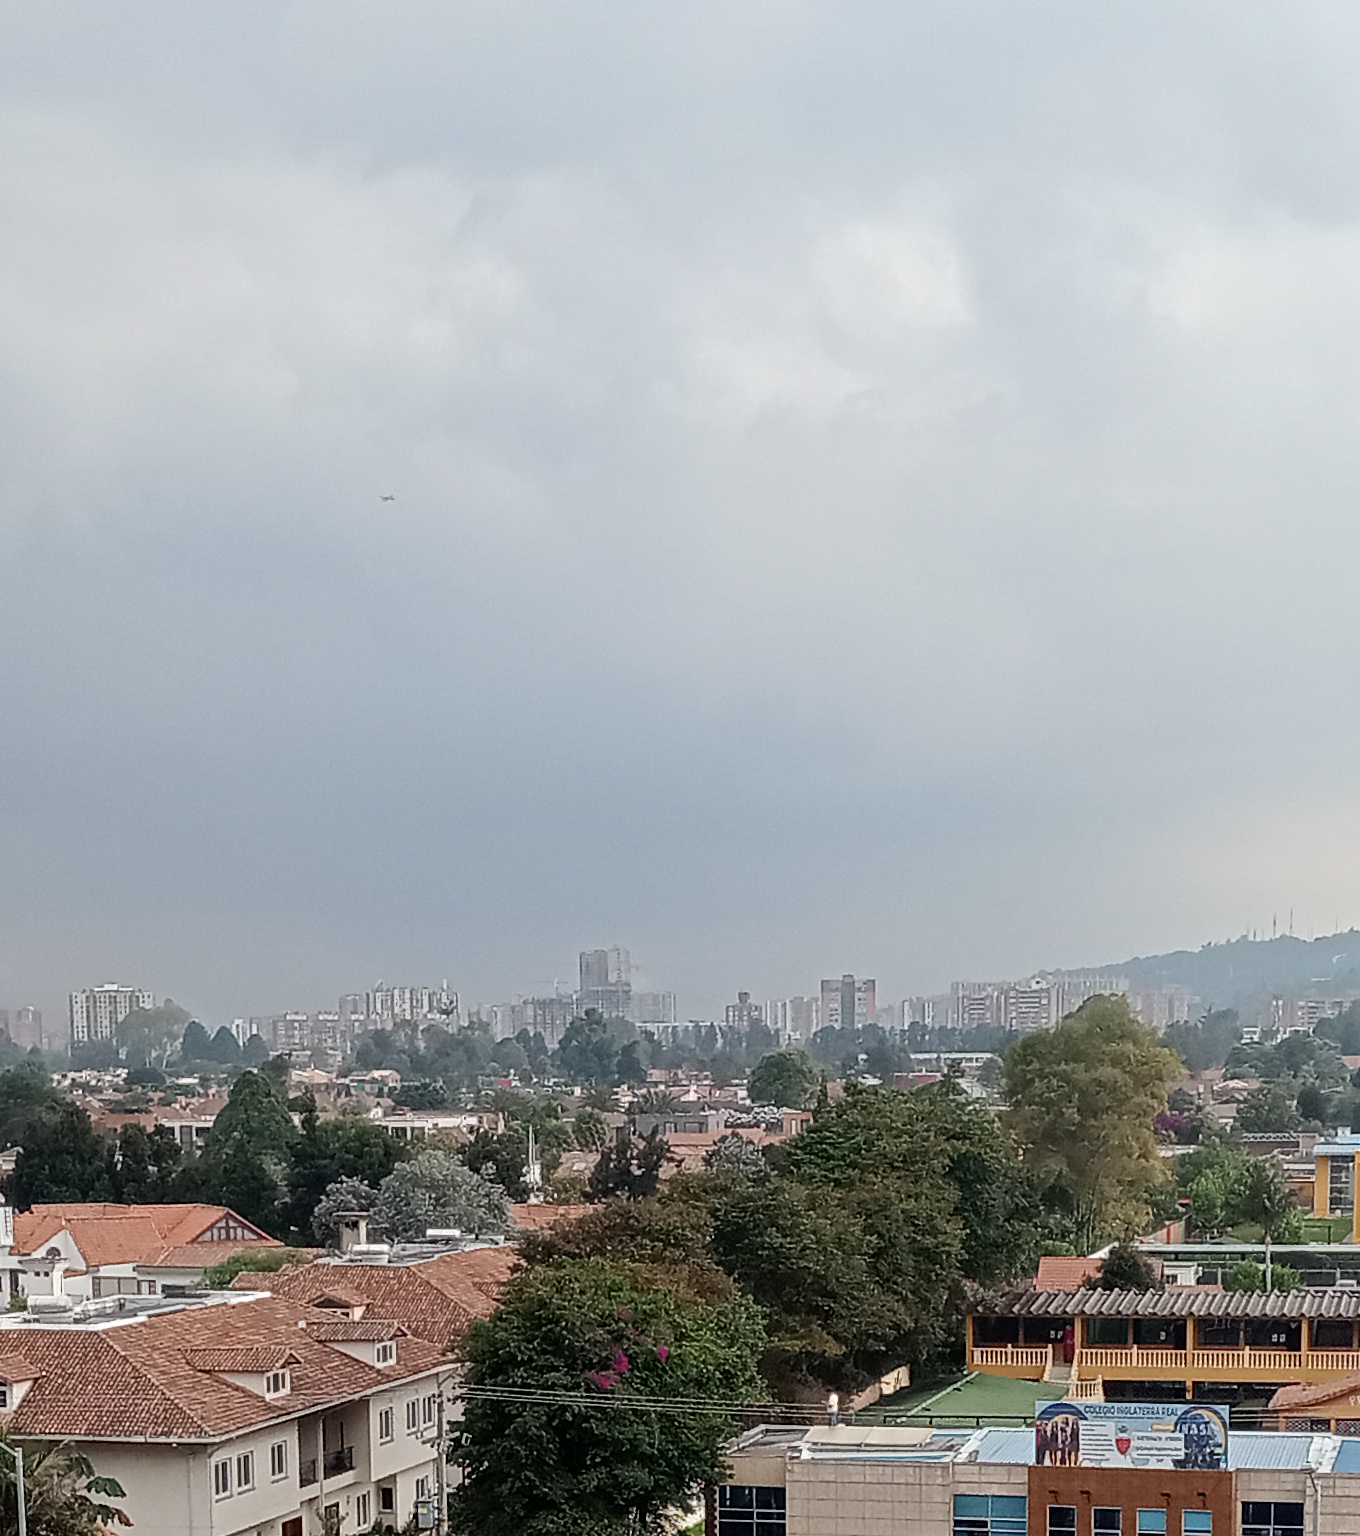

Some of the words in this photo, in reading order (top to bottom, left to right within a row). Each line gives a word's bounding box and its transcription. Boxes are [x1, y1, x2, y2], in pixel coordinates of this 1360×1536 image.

[1083, 1405, 1116, 1416] COLEGIO
[1117, 1406, 1161, 1417] INGLATERRA
[1161, 1407, 1179, 1417] REAL
